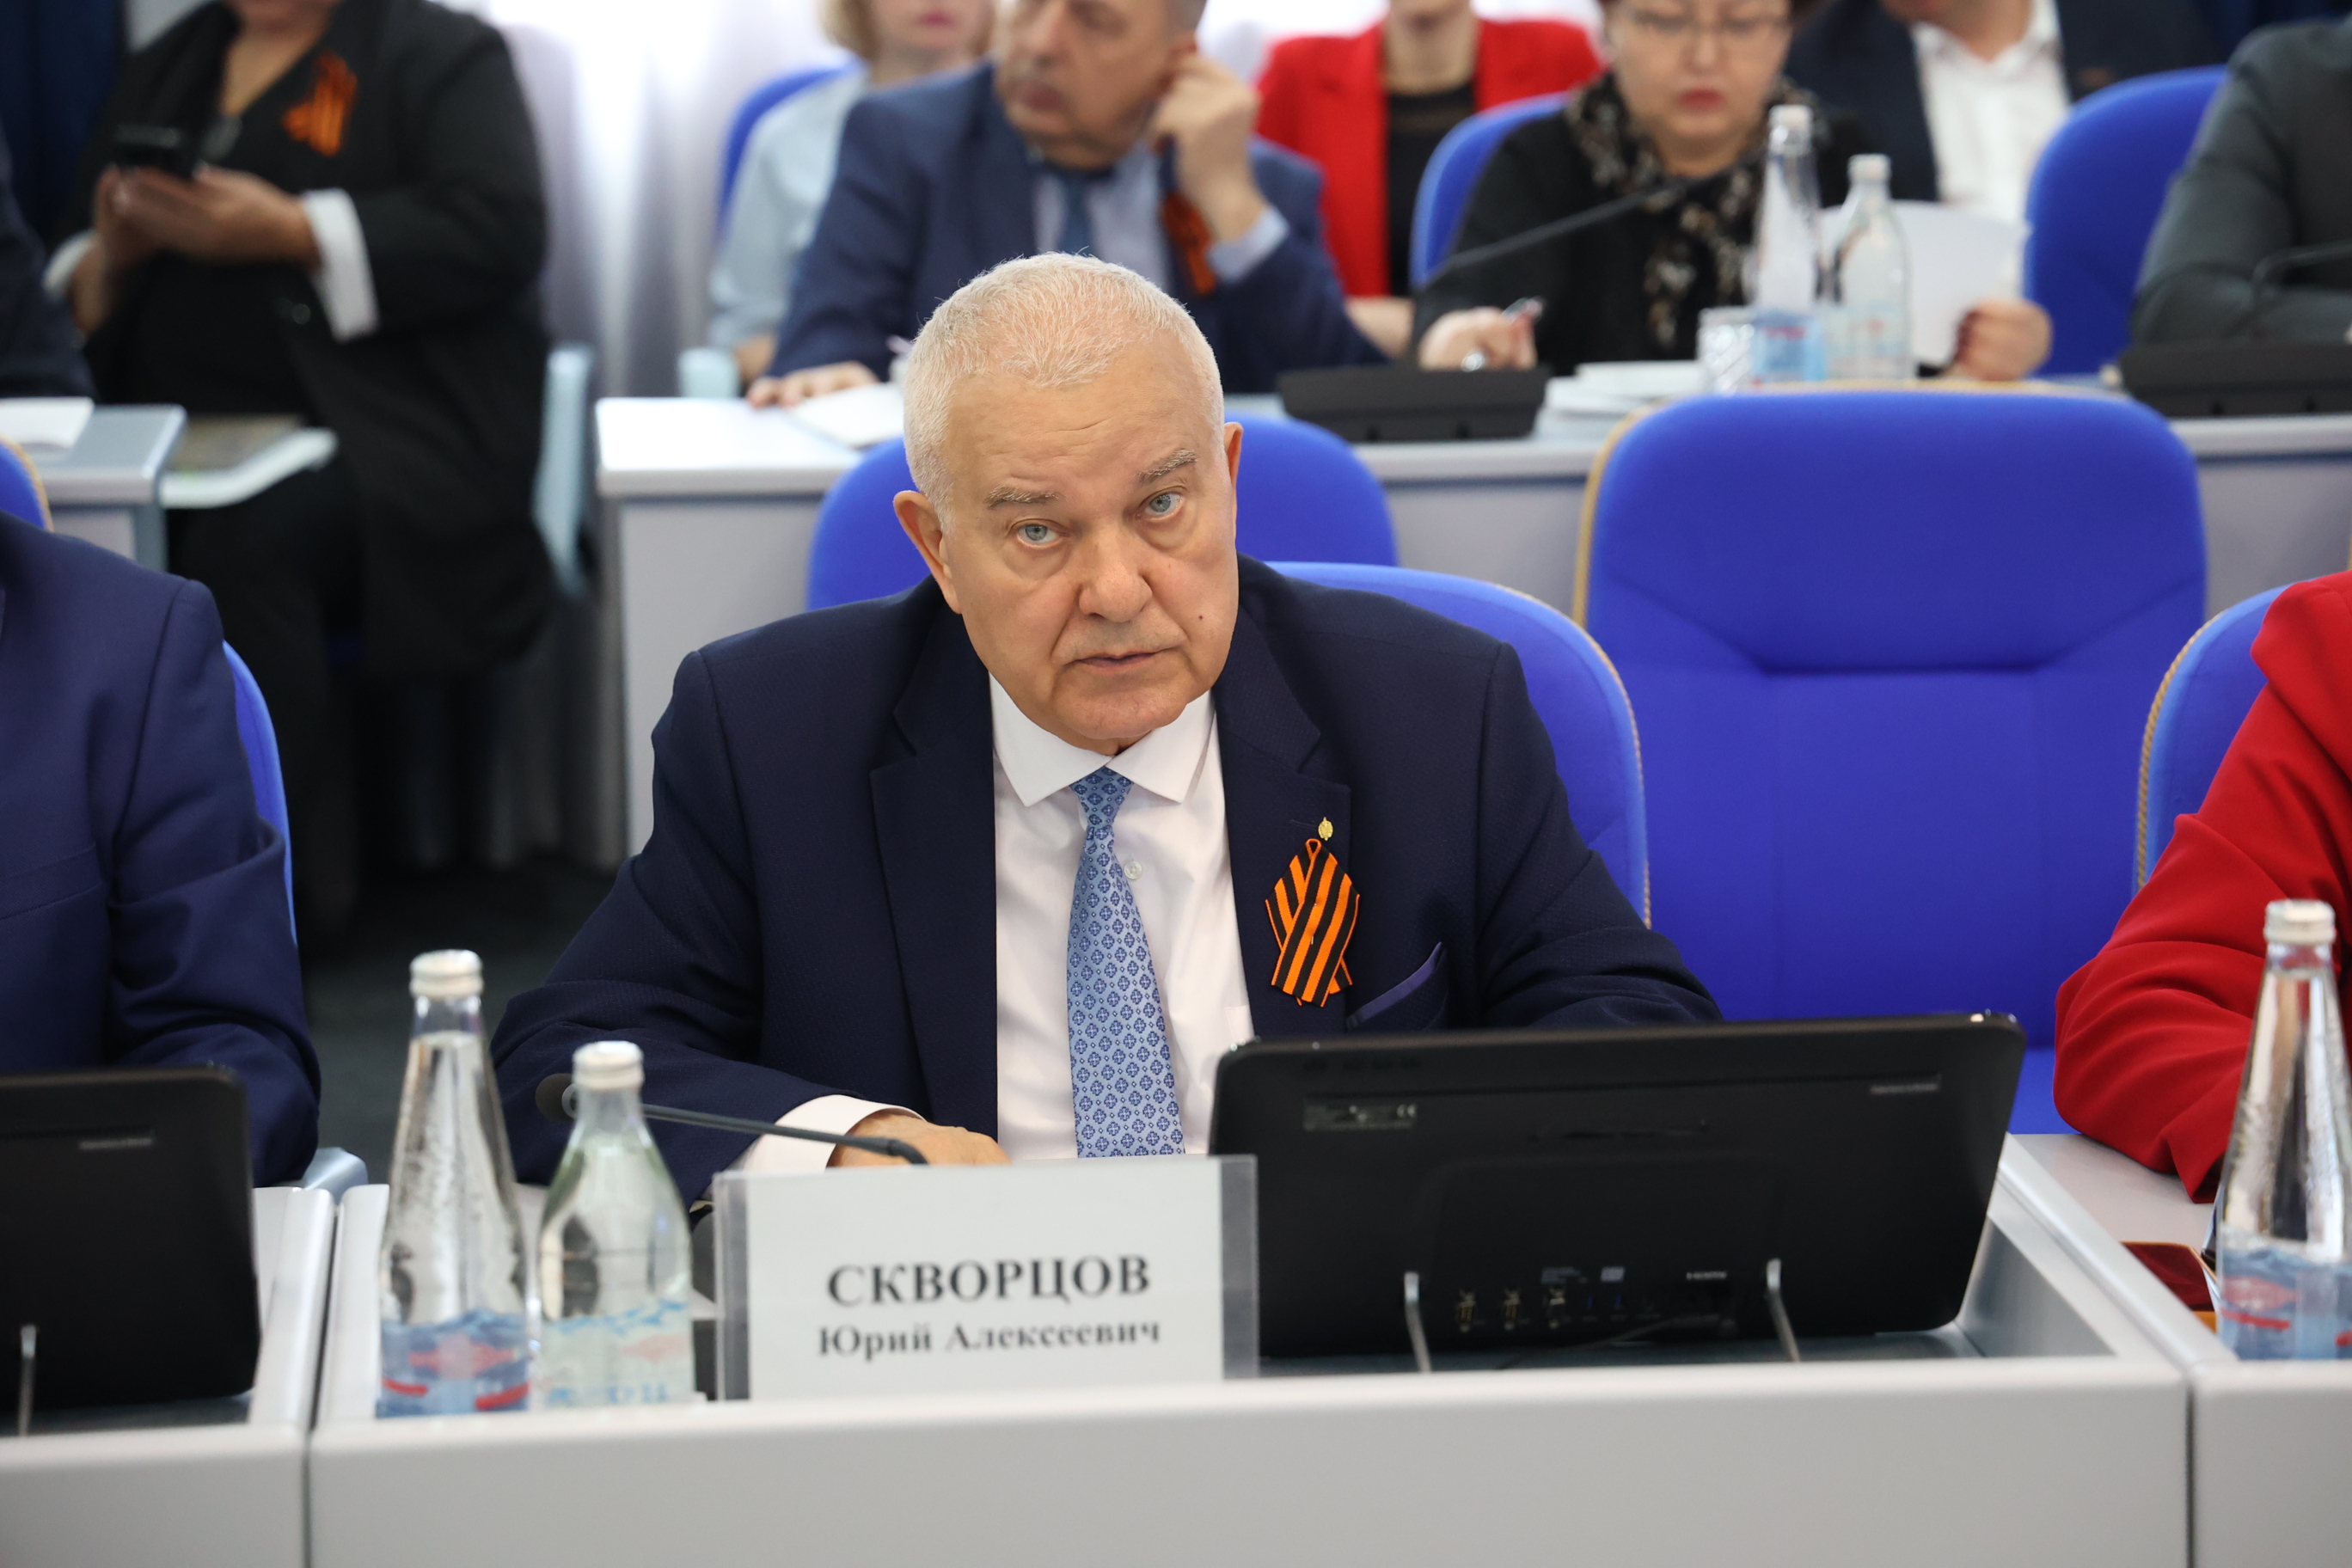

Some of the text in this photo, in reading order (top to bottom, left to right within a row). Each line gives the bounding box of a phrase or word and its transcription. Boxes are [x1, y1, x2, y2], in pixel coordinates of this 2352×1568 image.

[828, 1254, 1150, 1305] СКВОРЦОВ
[819, 1321, 1160, 1362] Юрий Алексеевич
